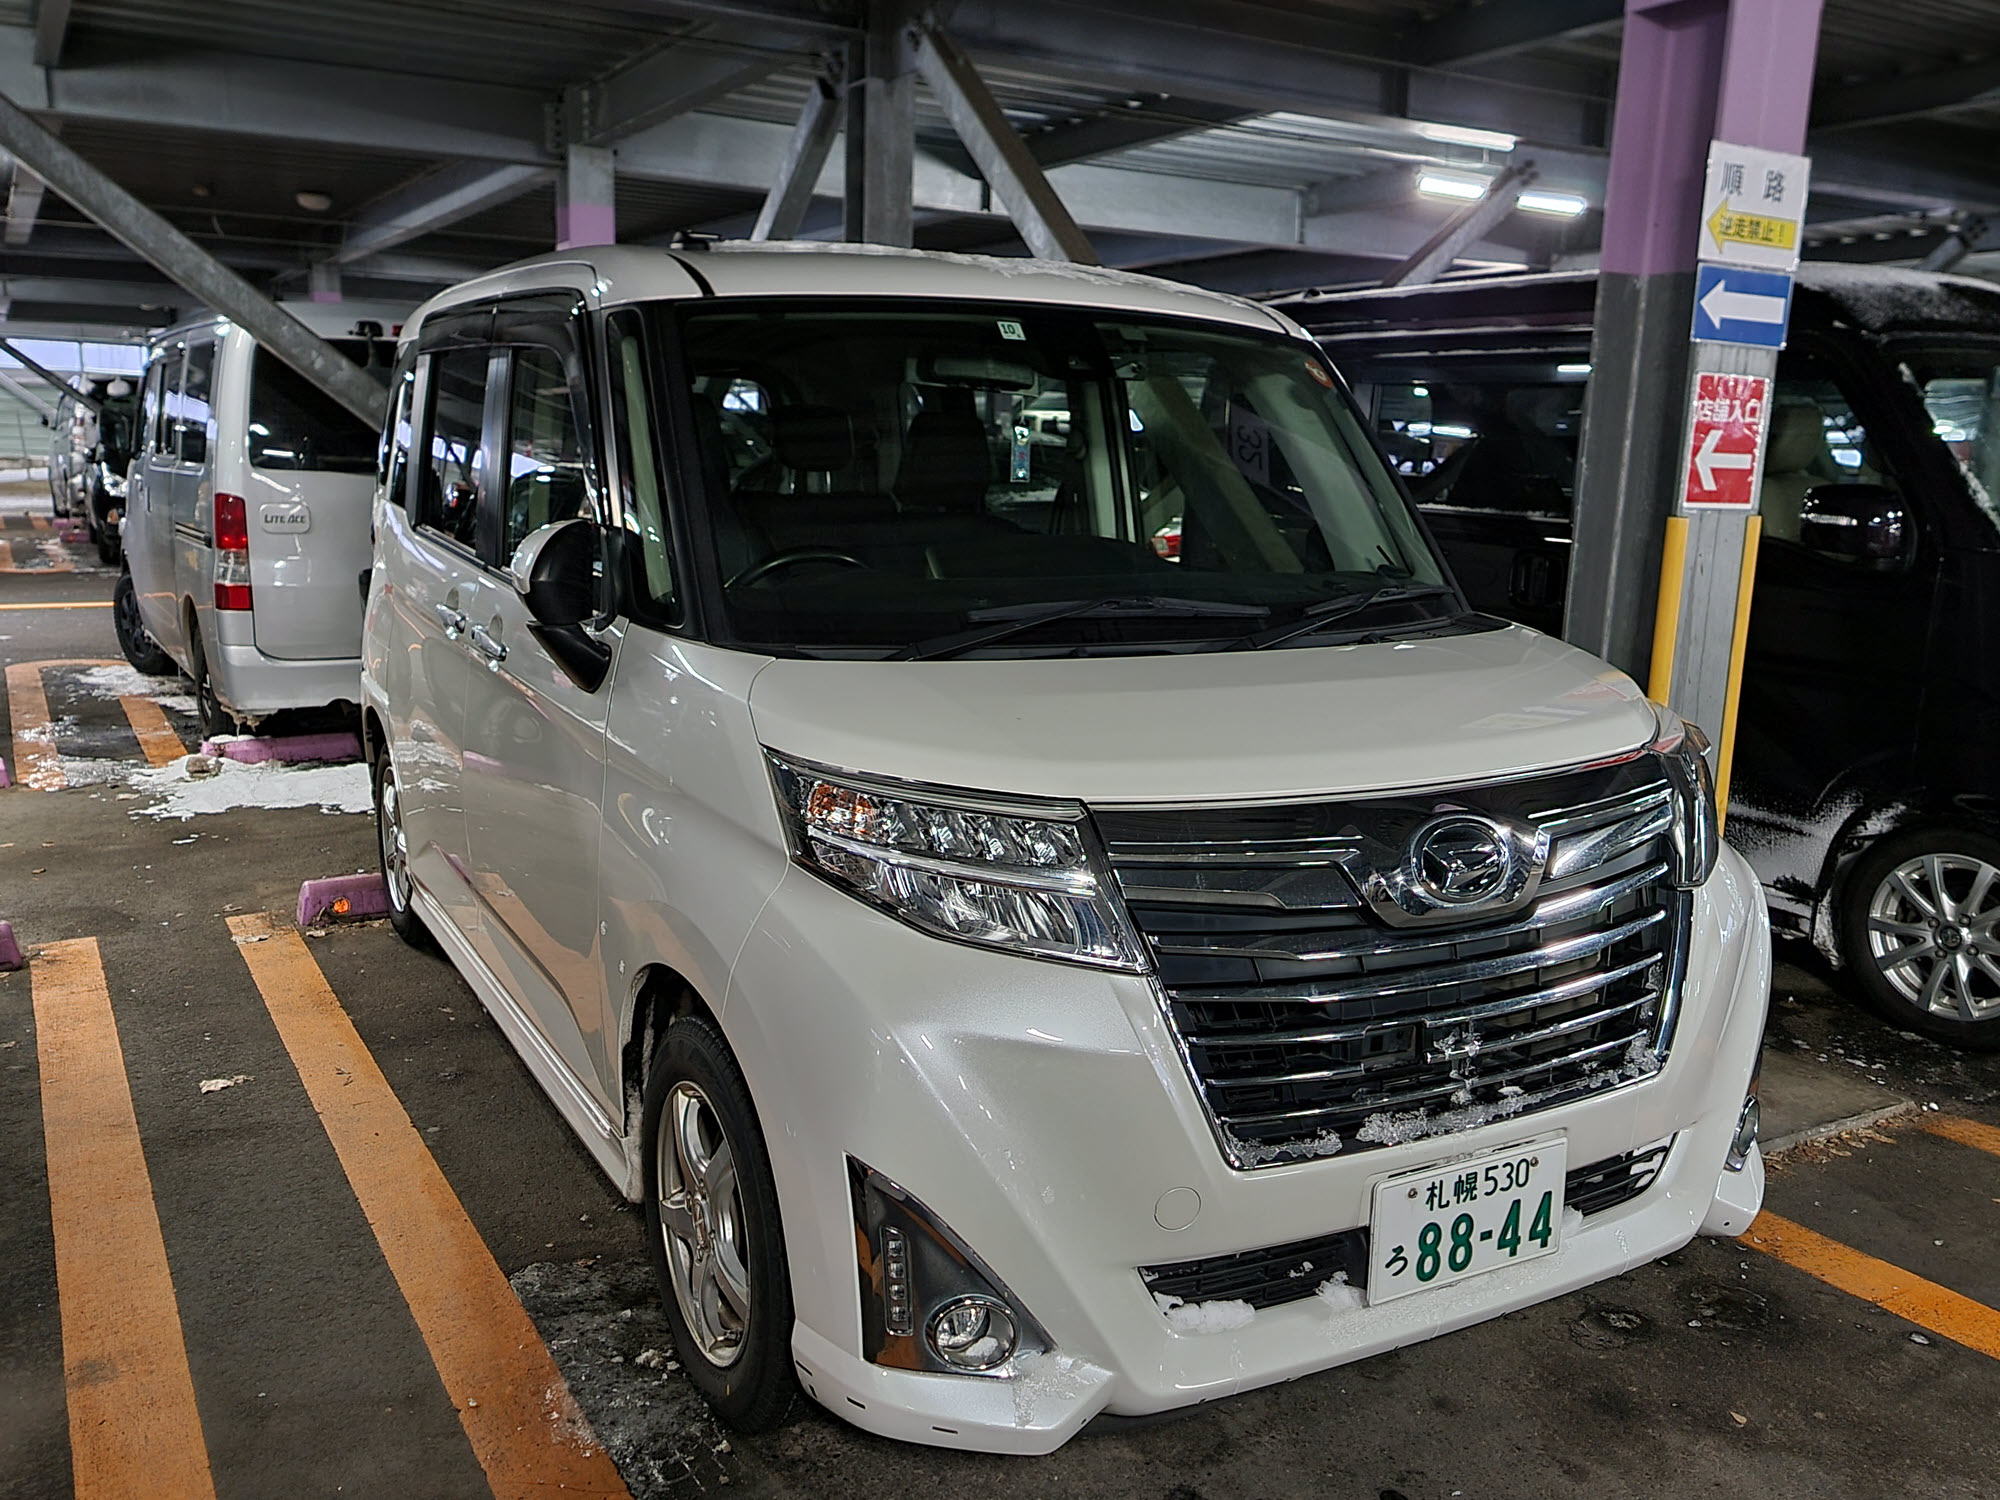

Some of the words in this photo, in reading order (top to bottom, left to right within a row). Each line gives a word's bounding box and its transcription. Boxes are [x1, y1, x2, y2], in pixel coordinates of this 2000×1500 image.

[1720, 160, 1785, 203] 順路
[1000, 324, 1016, 335] 10
[1696, 396, 1761, 425] 店舗入口
[264, 514, 286, 524] LITE
[287, 514, 306, 524] ACE
[1425, 1171, 1479, 1212] 札幌
[1484, 1158, 1530, 1197] 530
[1384, 1245, 1409, 1277] ろ
[1416, 1190, 1553, 1282] 88-44
